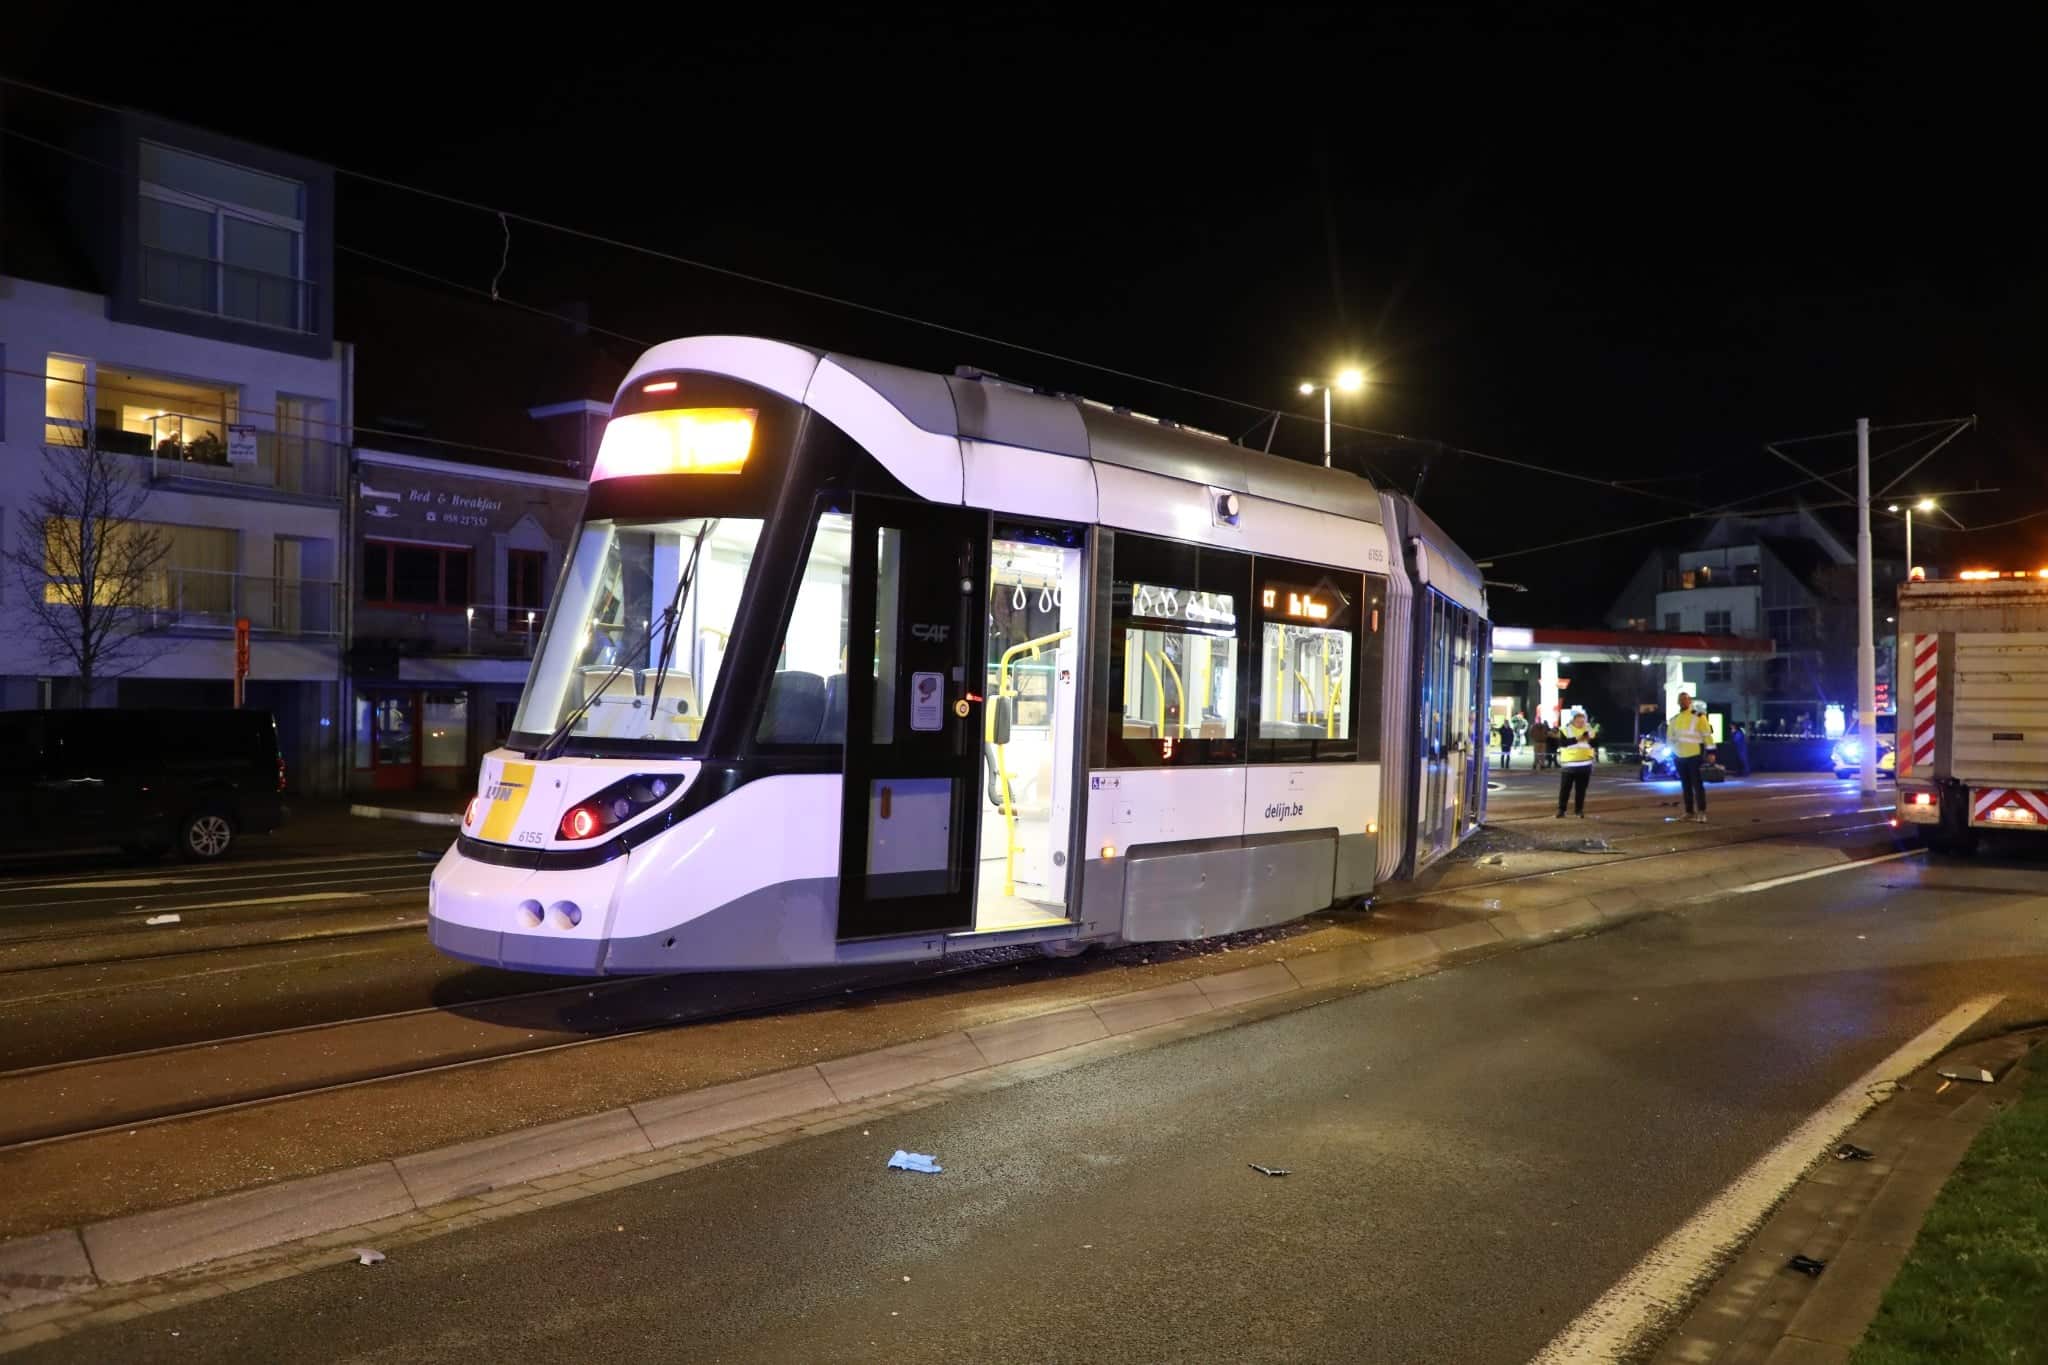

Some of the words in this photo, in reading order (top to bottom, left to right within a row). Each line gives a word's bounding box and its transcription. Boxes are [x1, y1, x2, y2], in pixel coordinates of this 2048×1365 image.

[409, 489, 431, 502] Bed
[437, 493, 447, 504] &
[452, 495, 502, 511] Breakfast
[1368, 548, 1384, 562] 6155
[912, 624, 950, 642] CAF
[1264, 802, 1304, 821] delijn.be
[519, 831, 543, 844] 6155
